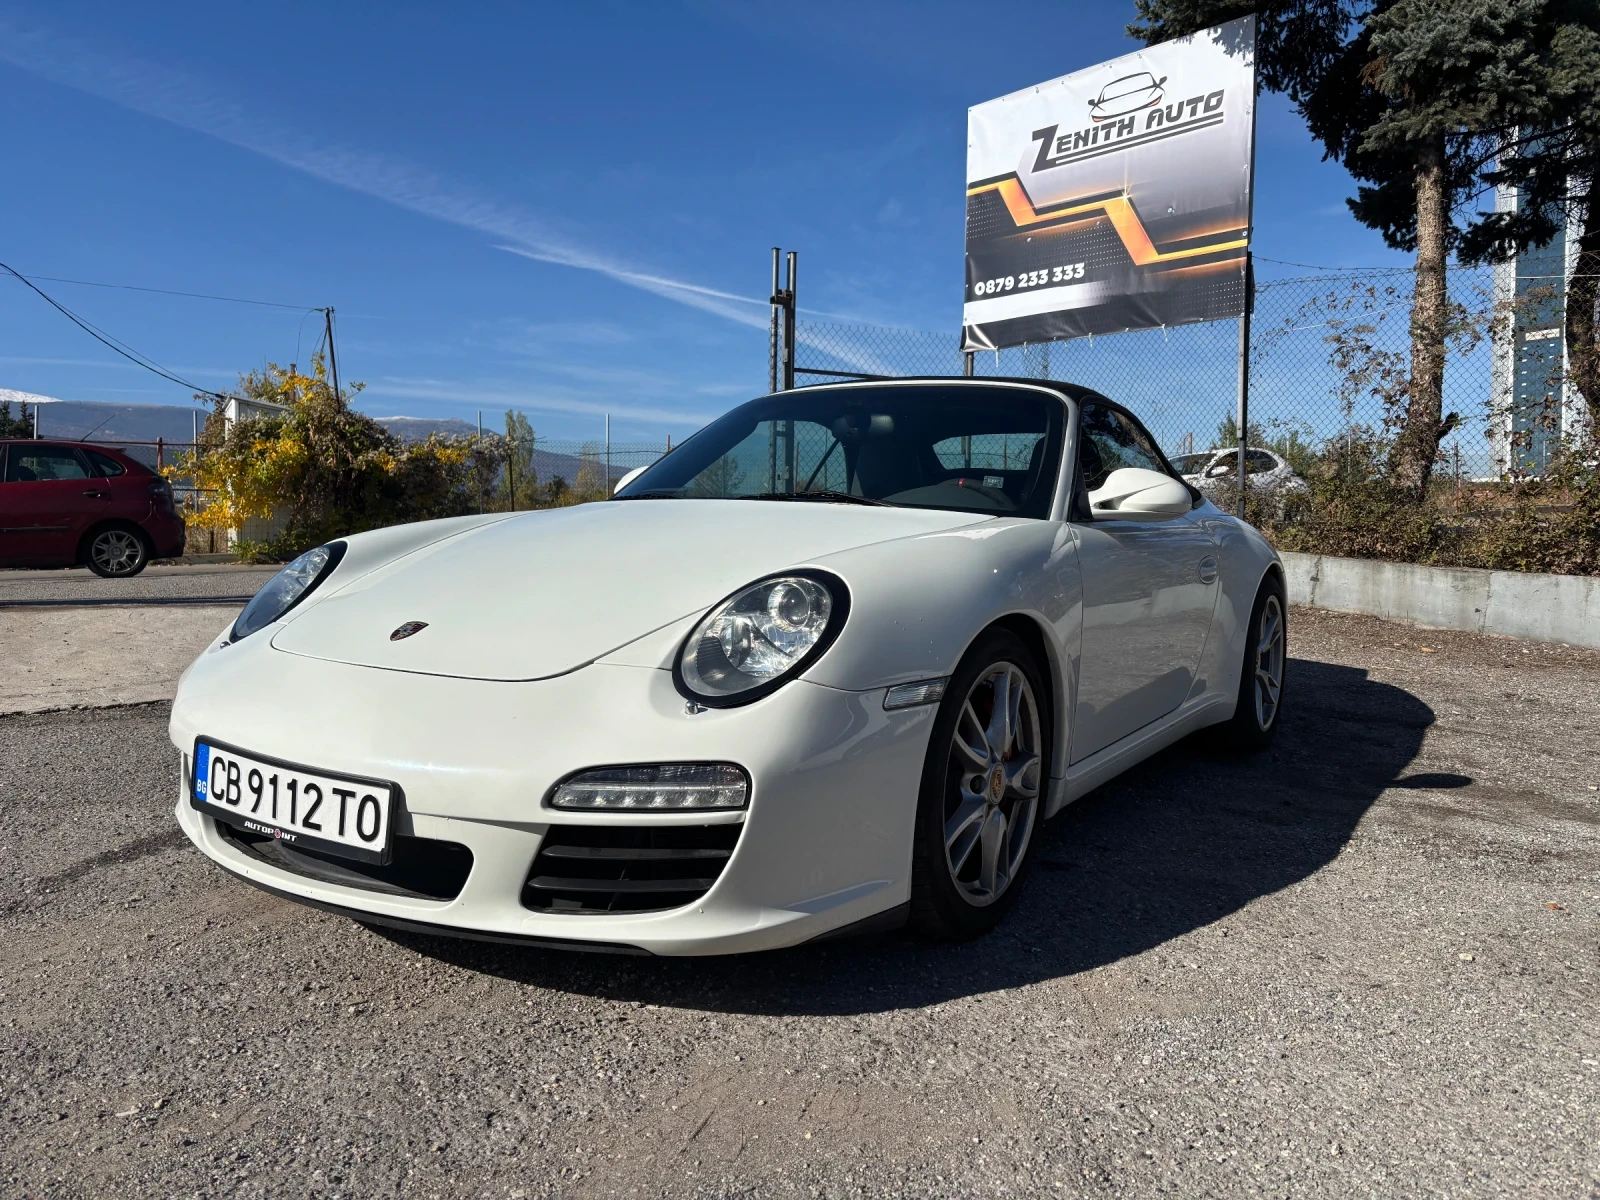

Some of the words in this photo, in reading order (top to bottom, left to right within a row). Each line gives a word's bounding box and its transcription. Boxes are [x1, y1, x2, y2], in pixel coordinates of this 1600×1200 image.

[1031, 115, 1136, 174] ZENITH
[1145, 89, 1225, 130] AUTO
[974, 276, 1015, 296] 0879
[1017, 269, 1049, 288] 233
[1052, 262, 1085, 282] 333
[196, 778, 207, 794] BG
